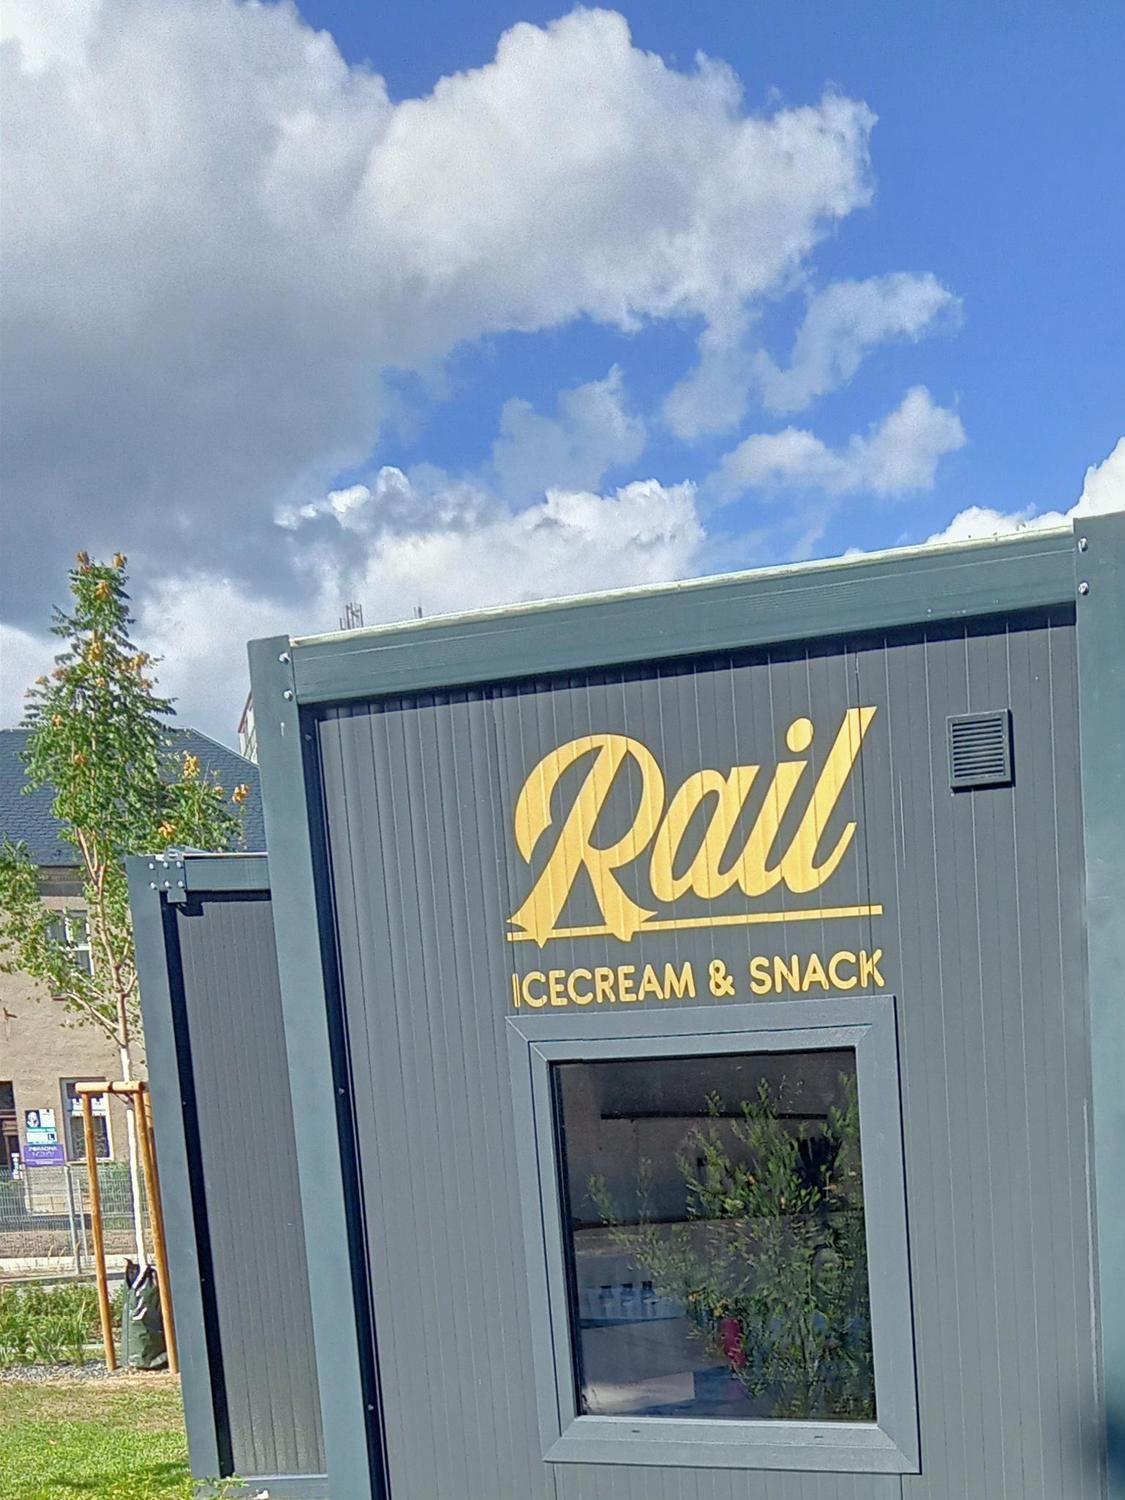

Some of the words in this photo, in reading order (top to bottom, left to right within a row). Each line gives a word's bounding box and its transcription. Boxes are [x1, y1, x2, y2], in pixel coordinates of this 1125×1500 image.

[507, 706, 877, 947] Rail
[512, 962, 696, 1008] ICECREAM
[708, 959, 735, 996] &
[749, 949, 885, 995] SNACK
